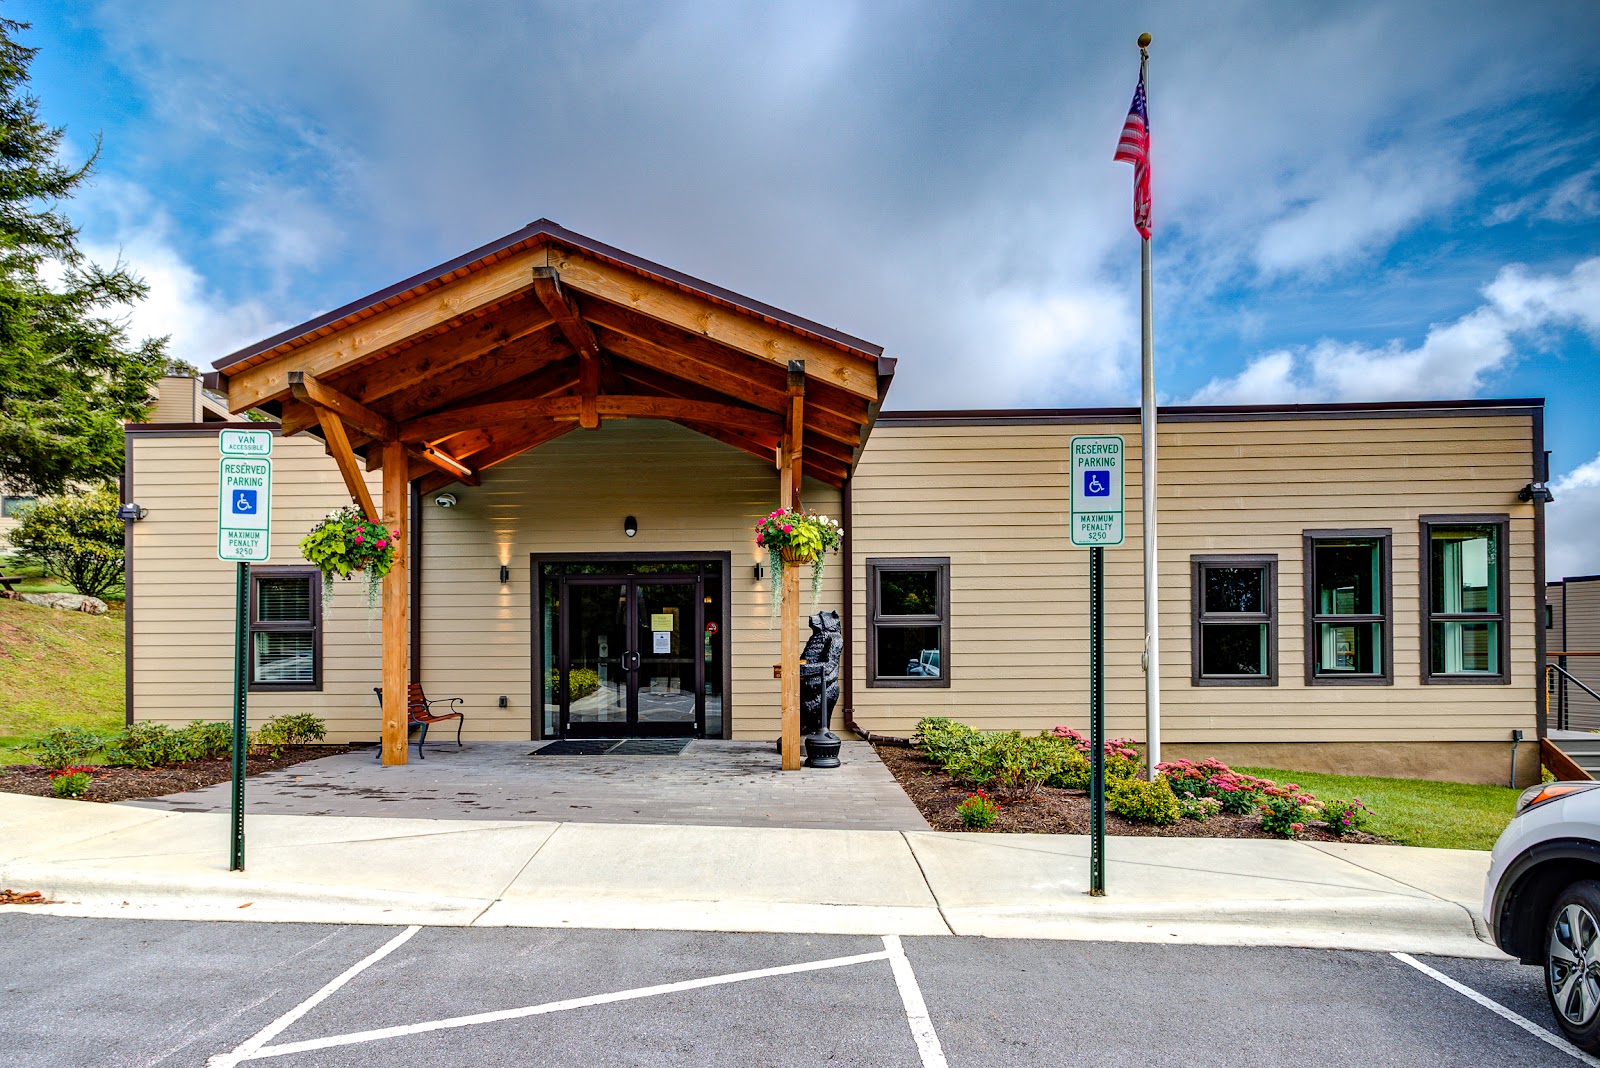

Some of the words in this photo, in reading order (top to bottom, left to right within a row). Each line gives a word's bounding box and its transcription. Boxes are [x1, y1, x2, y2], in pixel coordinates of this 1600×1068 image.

[1076, 444, 1119, 454] RESERVED
[1078, 458, 1116, 467] PARKING
[225, 464, 266, 474] RESERVED
[228, 476, 263, 486] PARKING
[1088, 532, 1107, 540] $250
